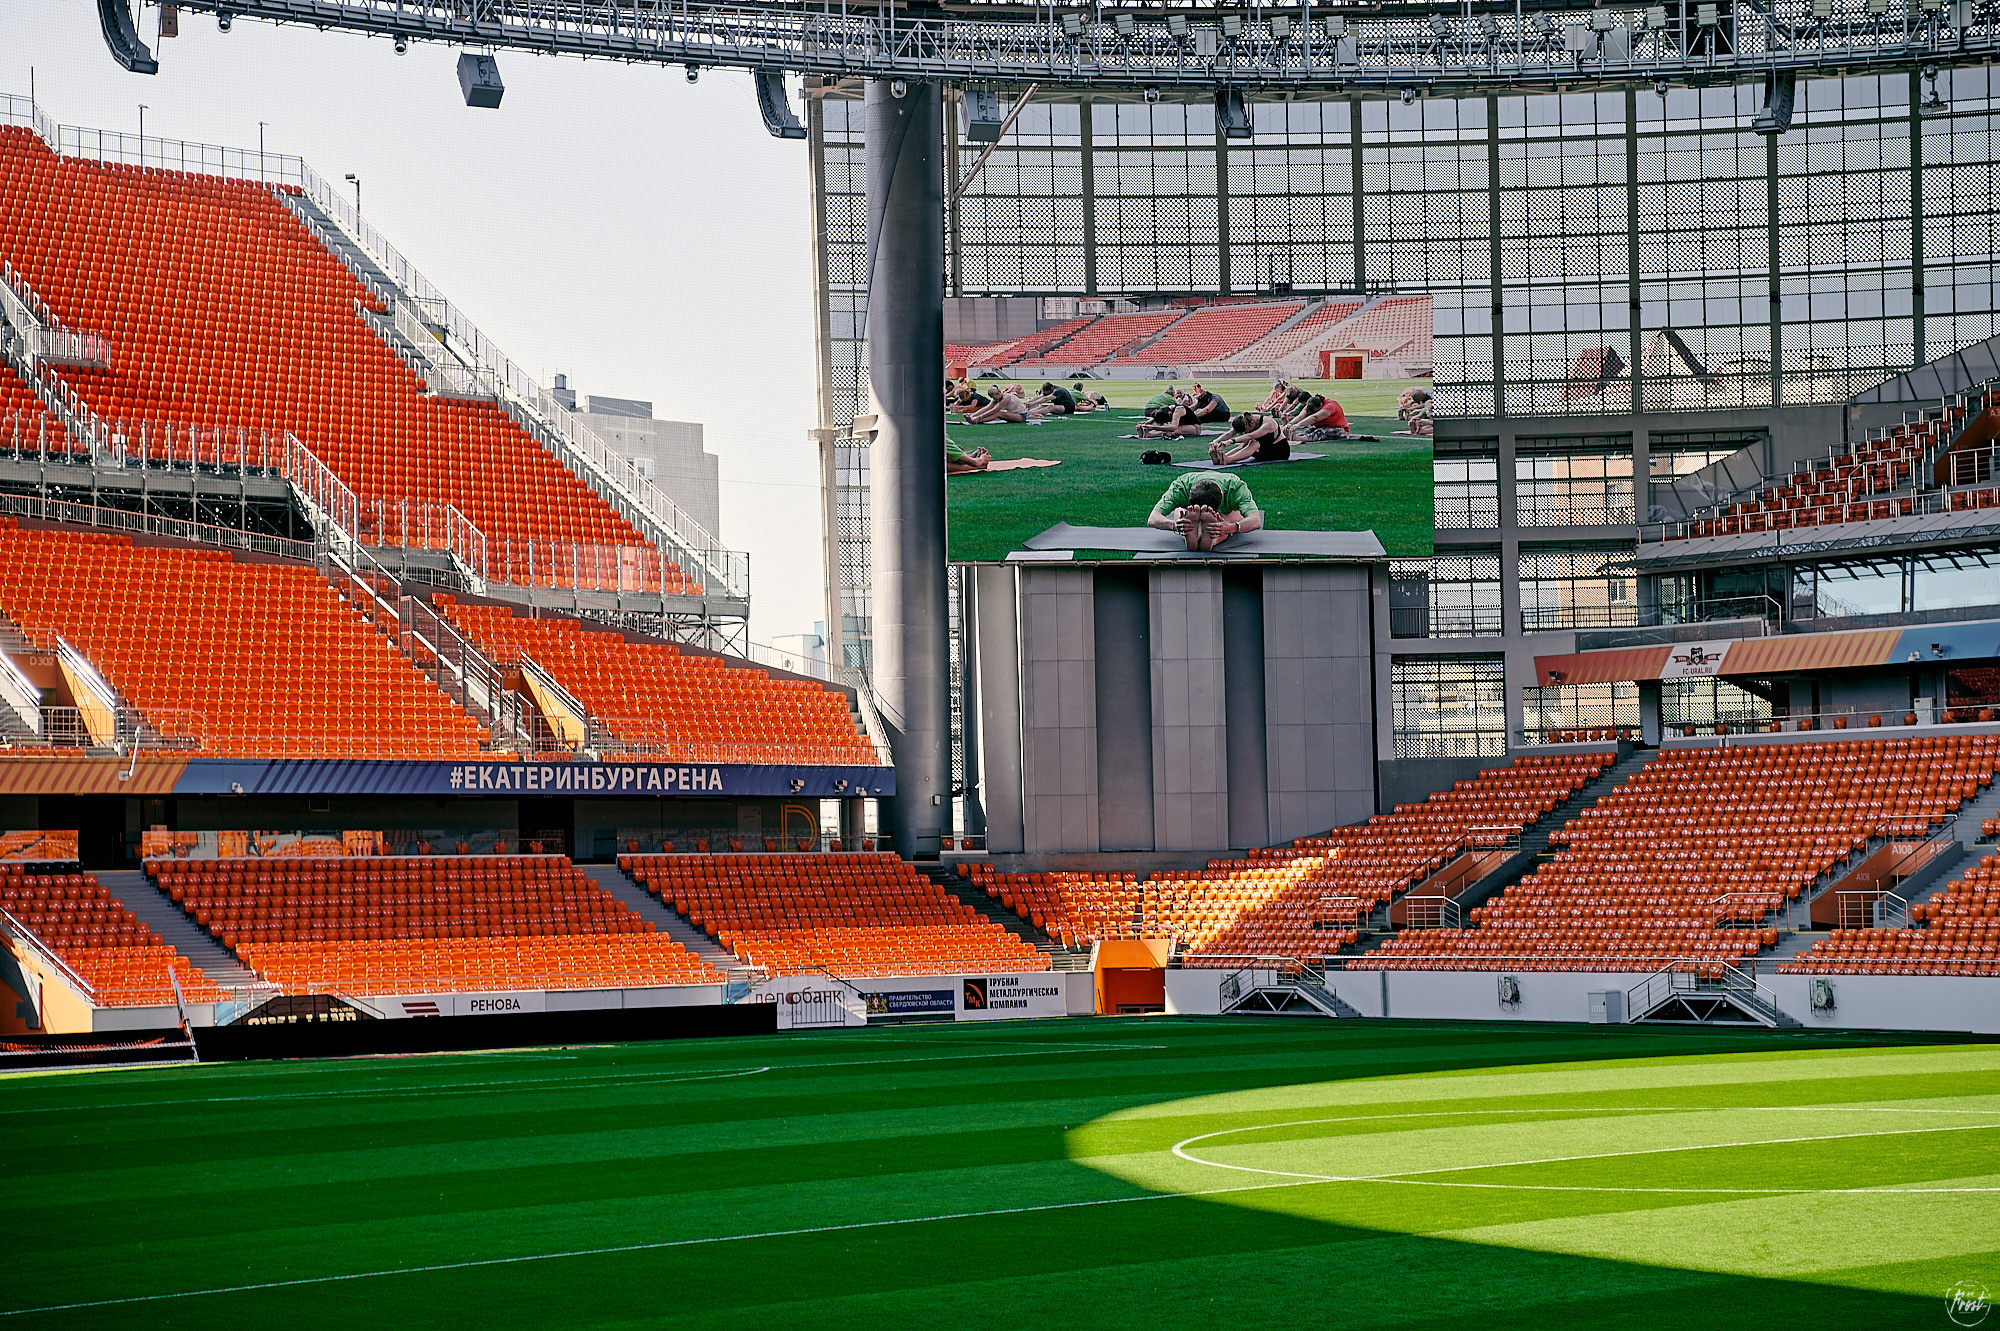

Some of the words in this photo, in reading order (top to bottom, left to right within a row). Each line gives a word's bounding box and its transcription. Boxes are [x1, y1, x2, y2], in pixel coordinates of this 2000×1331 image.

[450, 766, 723, 791] #ЕКАТЕРИНБУРГАРЕНА
[1892, 844, 1913, 855] A108
[989, 977, 1019, 987] ТРУБНАЯ
[888, 993, 933, 1002] ПРАВИТЕЛЬСТВО
[989, 987, 1059, 999] МЕТАЛЛУРГИЧЕСКАЯ
[470, 998, 521, 1012] РЕНОВА
[888, 1000, 929, 1008] СВЕРДЛОВСКОЙ
[965, 992, 981, 1008] ТМК
[989, 999, 1028, 1010] КОМПАНИЯ
